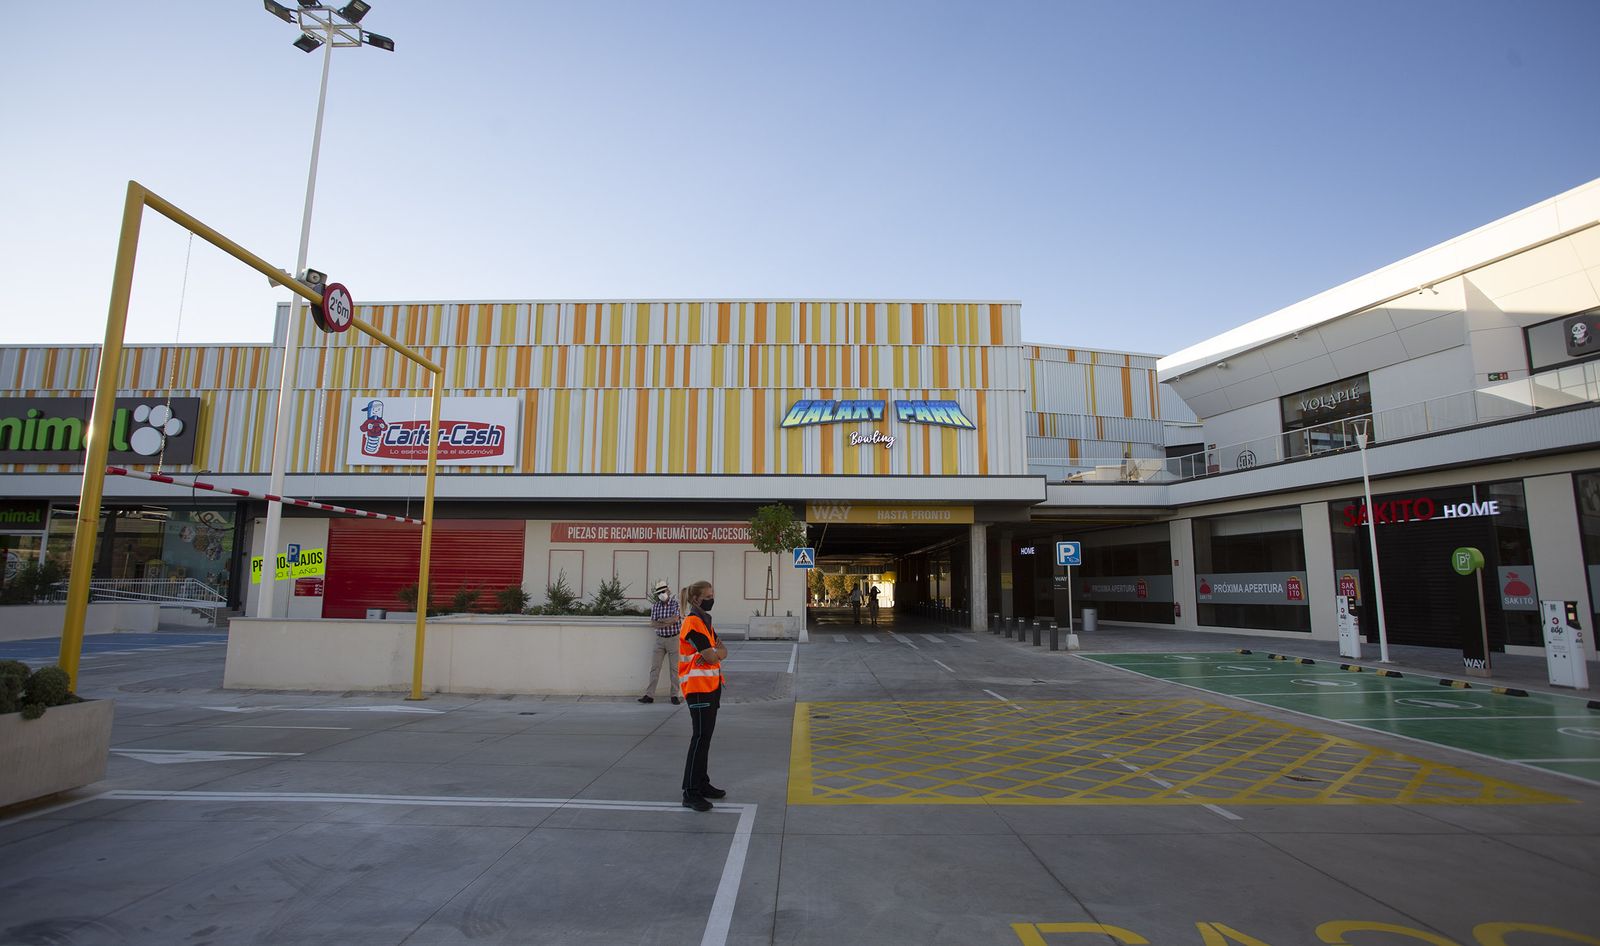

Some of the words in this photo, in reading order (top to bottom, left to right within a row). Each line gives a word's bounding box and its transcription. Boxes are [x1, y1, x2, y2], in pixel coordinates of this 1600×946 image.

[1300, 383, 1360, 412] VOLAPIÉ
[781, 399, 886, 428] GALAXY
[894, 399, 977, 430] PARK
[849, 430, 896, 449] Bowling
[812, 504, 852, 520] WAY
[877, 509, 909, 520] HASTA
[911, 510, 951, 520] PRONTO
[1343, 497, 1435, 527] SAKITO
[1444, 500, 1500, 518] HOME
[568, 526, 596, 540] PIEZAS
[598, 527, 609, 540] DE
[1213, 582, 1243, 594] PRÓXIMA
[1244, 583, 1284, 593] APERTURA
[1504, 597, 1534, 605] SAKITO
[1463, 657, 1486, 669] WAY
